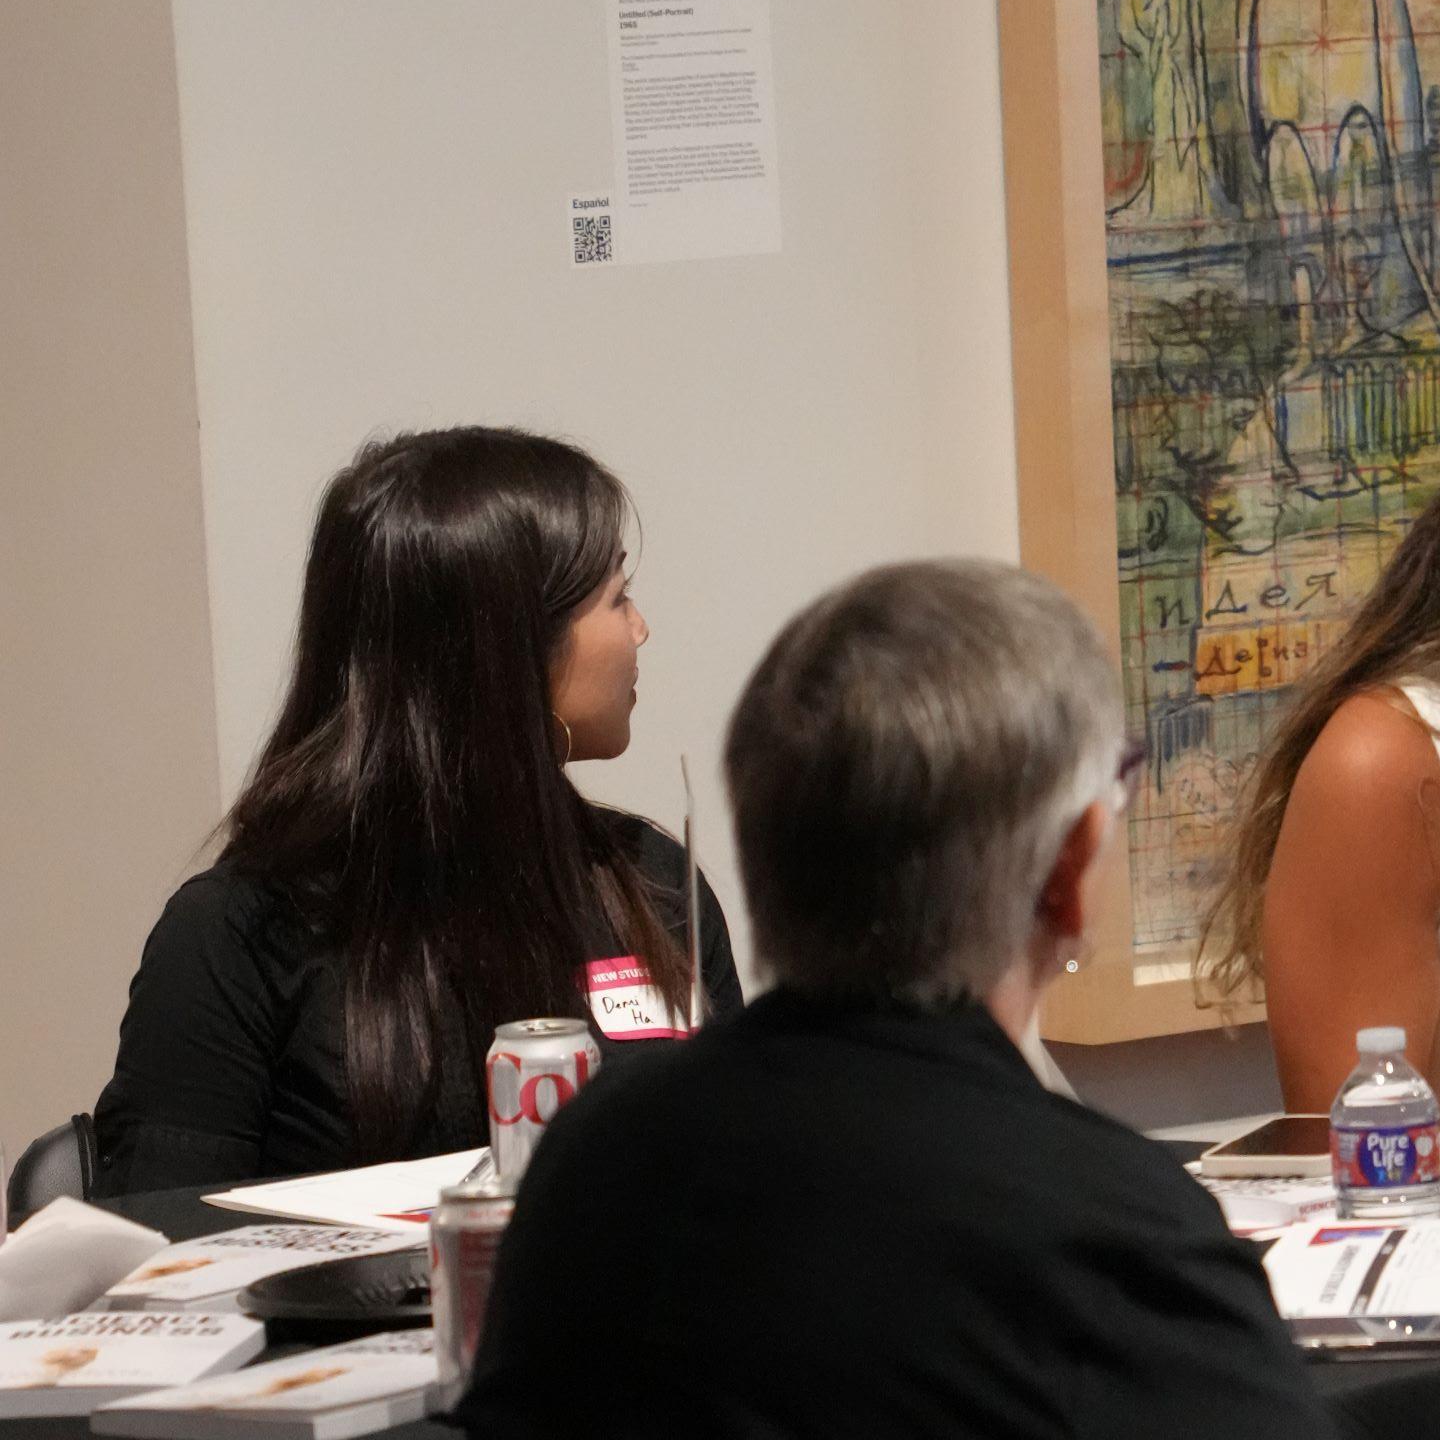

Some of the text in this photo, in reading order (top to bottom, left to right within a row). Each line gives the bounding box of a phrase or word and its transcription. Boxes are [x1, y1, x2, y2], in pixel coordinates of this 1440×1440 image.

[619, 10, 646, 19] Untitled
[573, 197, 609, 210] Español
[592, 971, 618, 984] NEW
[1367, 1132, 1409, 1151] Pure
[1373, 1149, 1405, 1171] Life
